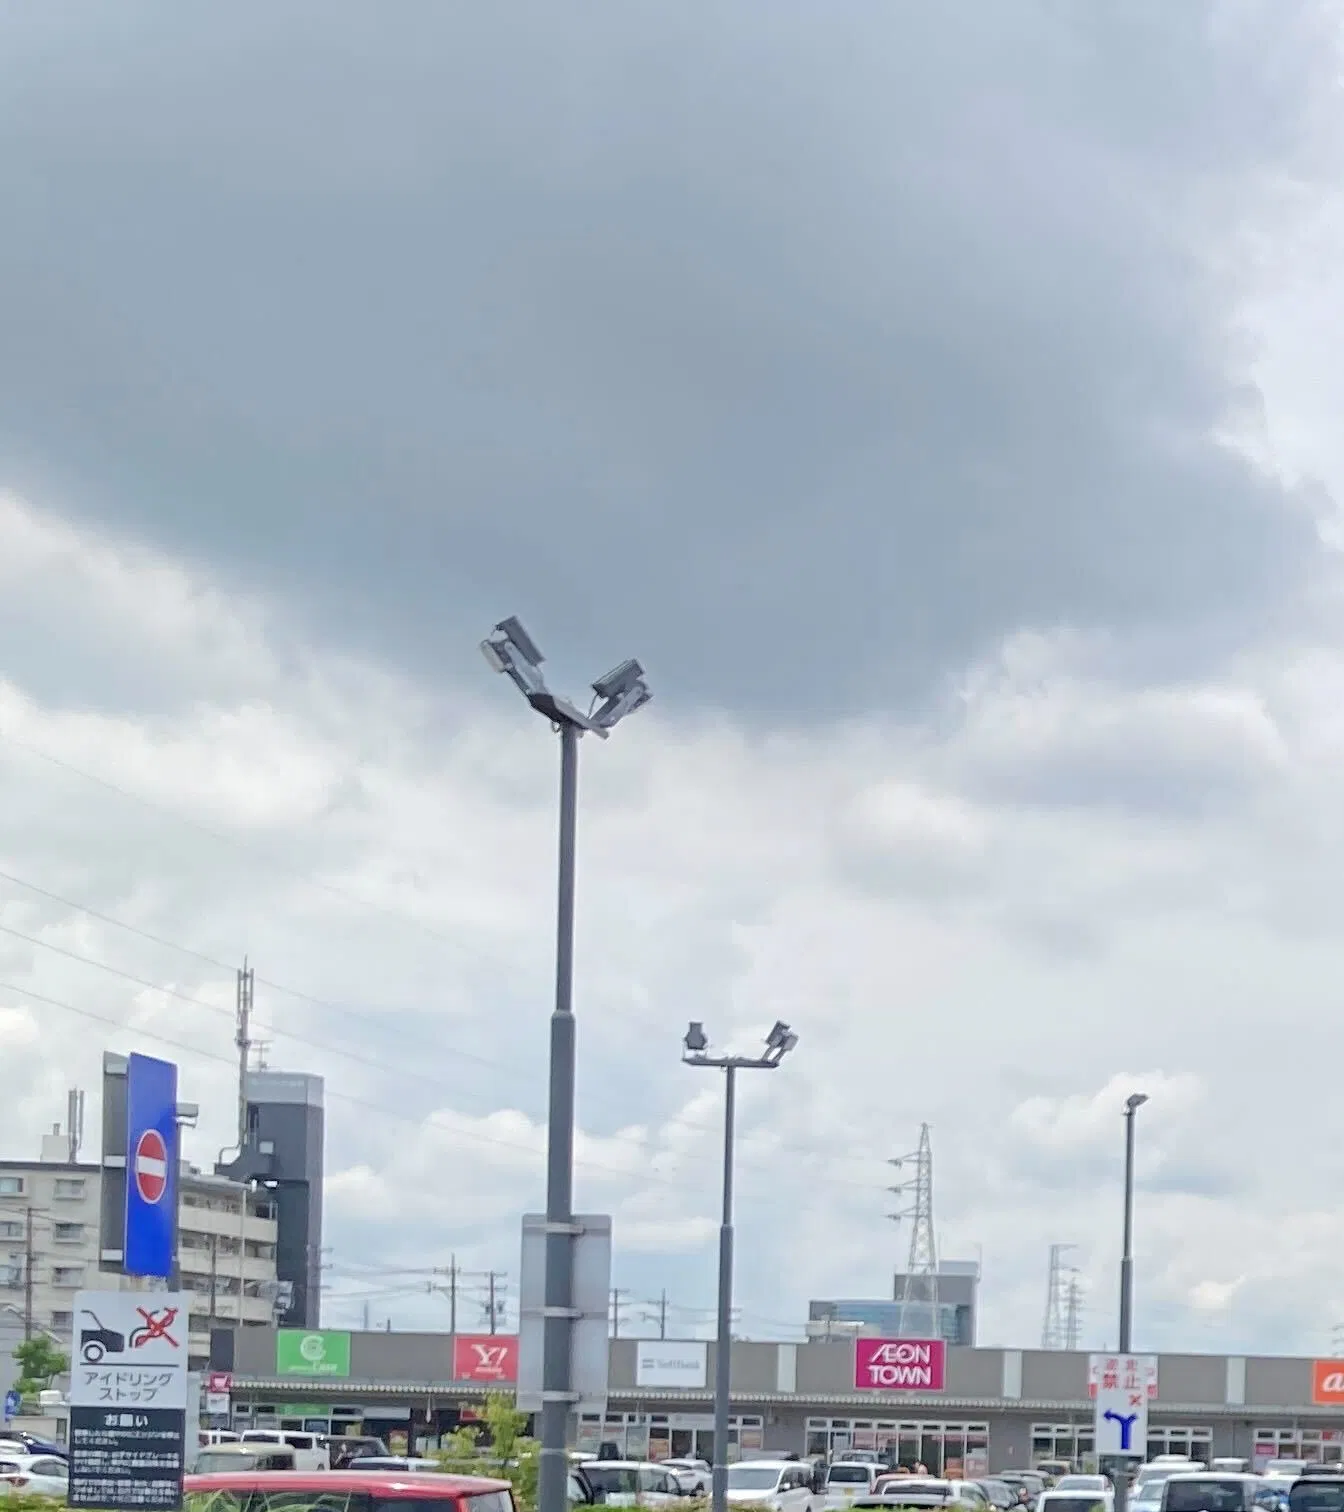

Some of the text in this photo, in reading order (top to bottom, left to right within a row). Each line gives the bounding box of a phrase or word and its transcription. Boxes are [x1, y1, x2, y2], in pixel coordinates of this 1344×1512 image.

[84, 1371, 174, 1386] アイドリング
[867, 1364, 932, 1385] TOWN
[99, 1387, 158, 1401] ストップ
